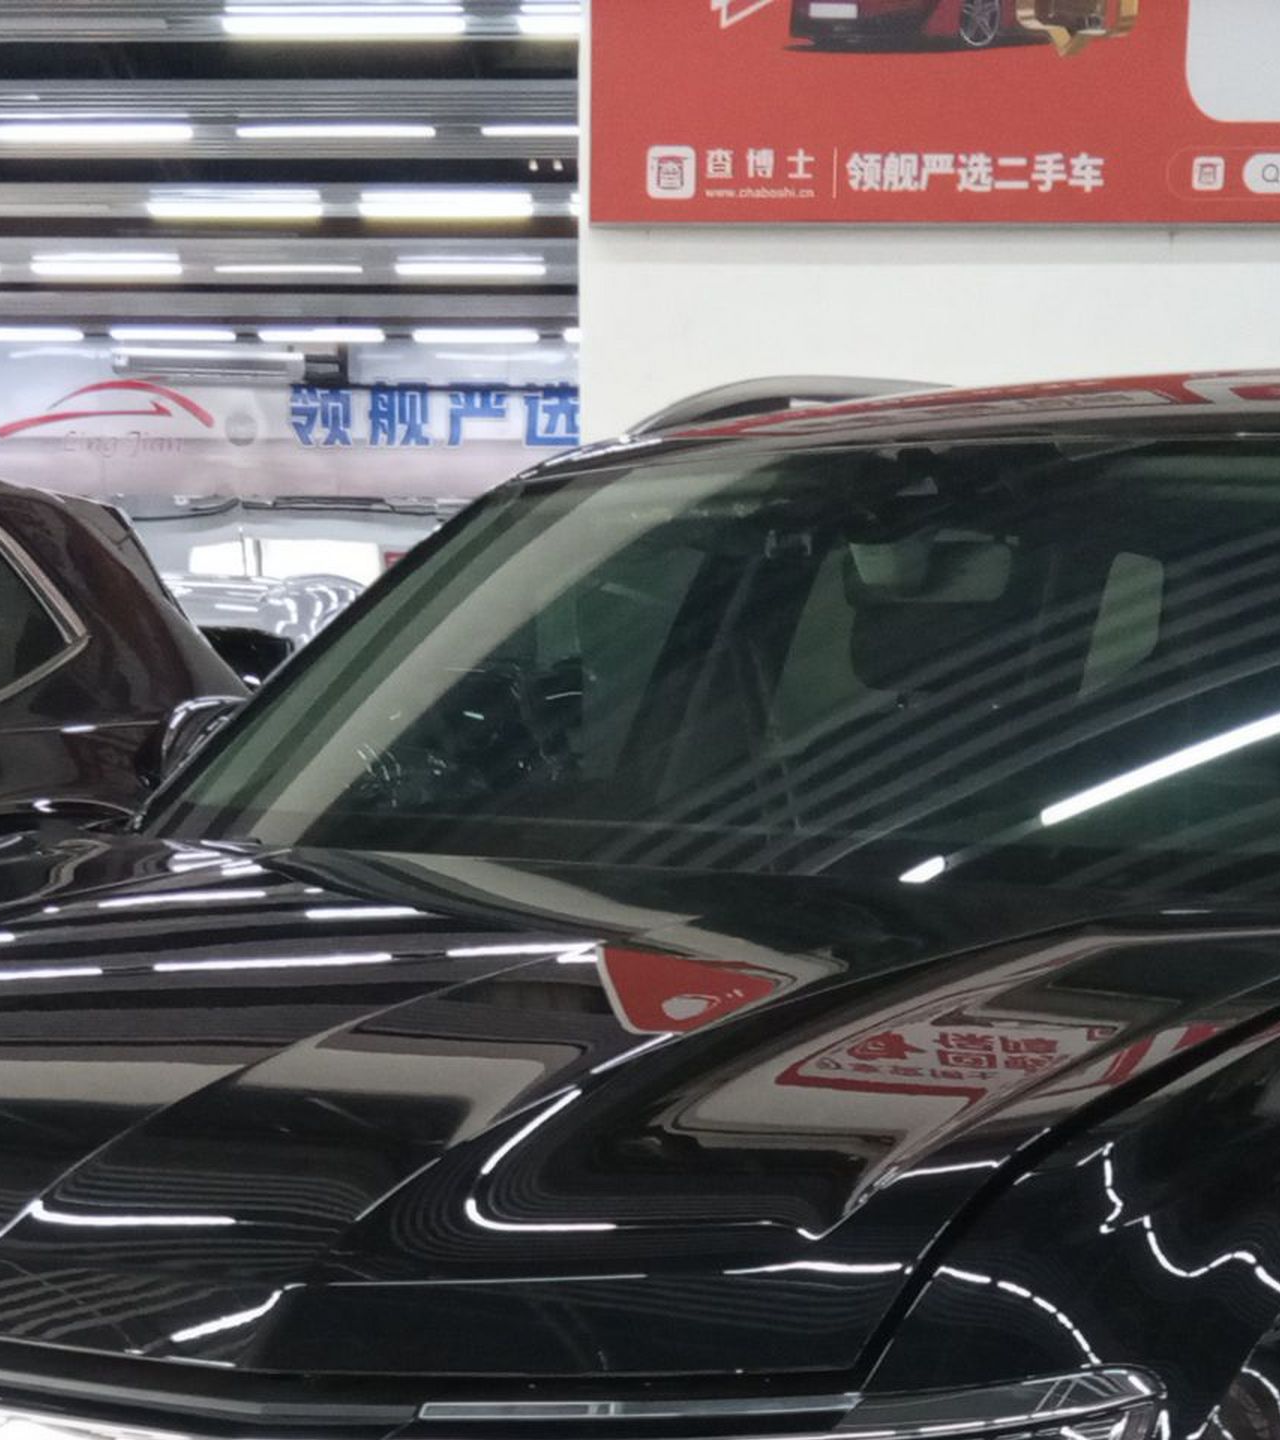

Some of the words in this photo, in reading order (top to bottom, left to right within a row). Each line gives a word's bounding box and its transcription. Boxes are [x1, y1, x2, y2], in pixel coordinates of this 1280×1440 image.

[706, 148, 815, 179] 查博士
[846, 152, 1105, 193] 领舰严选二手车
[289, 380, 579, 448] 领舰严选
